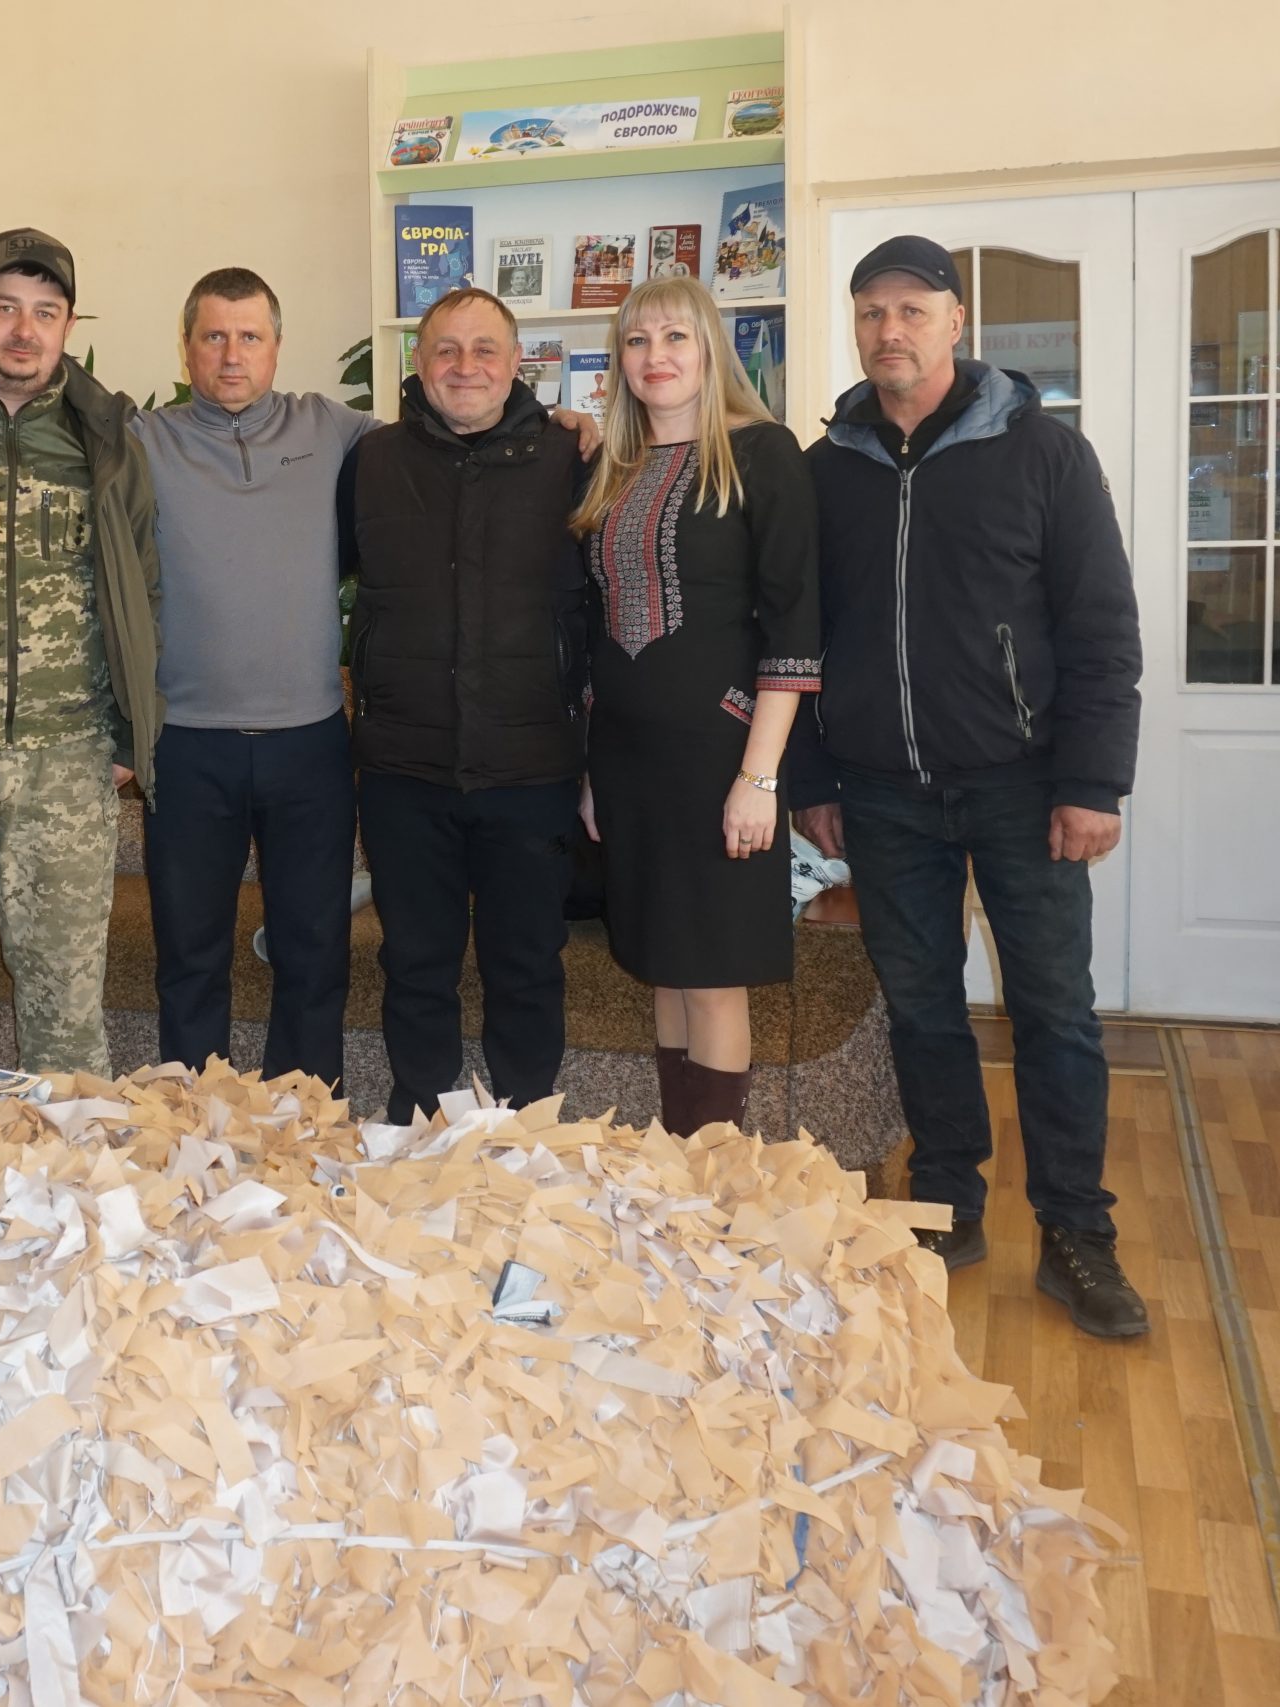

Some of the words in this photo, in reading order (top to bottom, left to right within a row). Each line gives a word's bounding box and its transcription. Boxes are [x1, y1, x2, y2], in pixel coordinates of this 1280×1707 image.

[600, 103, 698, 124] ПОДОРОЖУЄМО
[613, 124, 678, 138] ЄВРОПОЮ
[401, 226, 470, 240] ЄВРОПА-
[420, 242, 449, 256] ГРА
[499, 252, 543, 266] HAVEL
